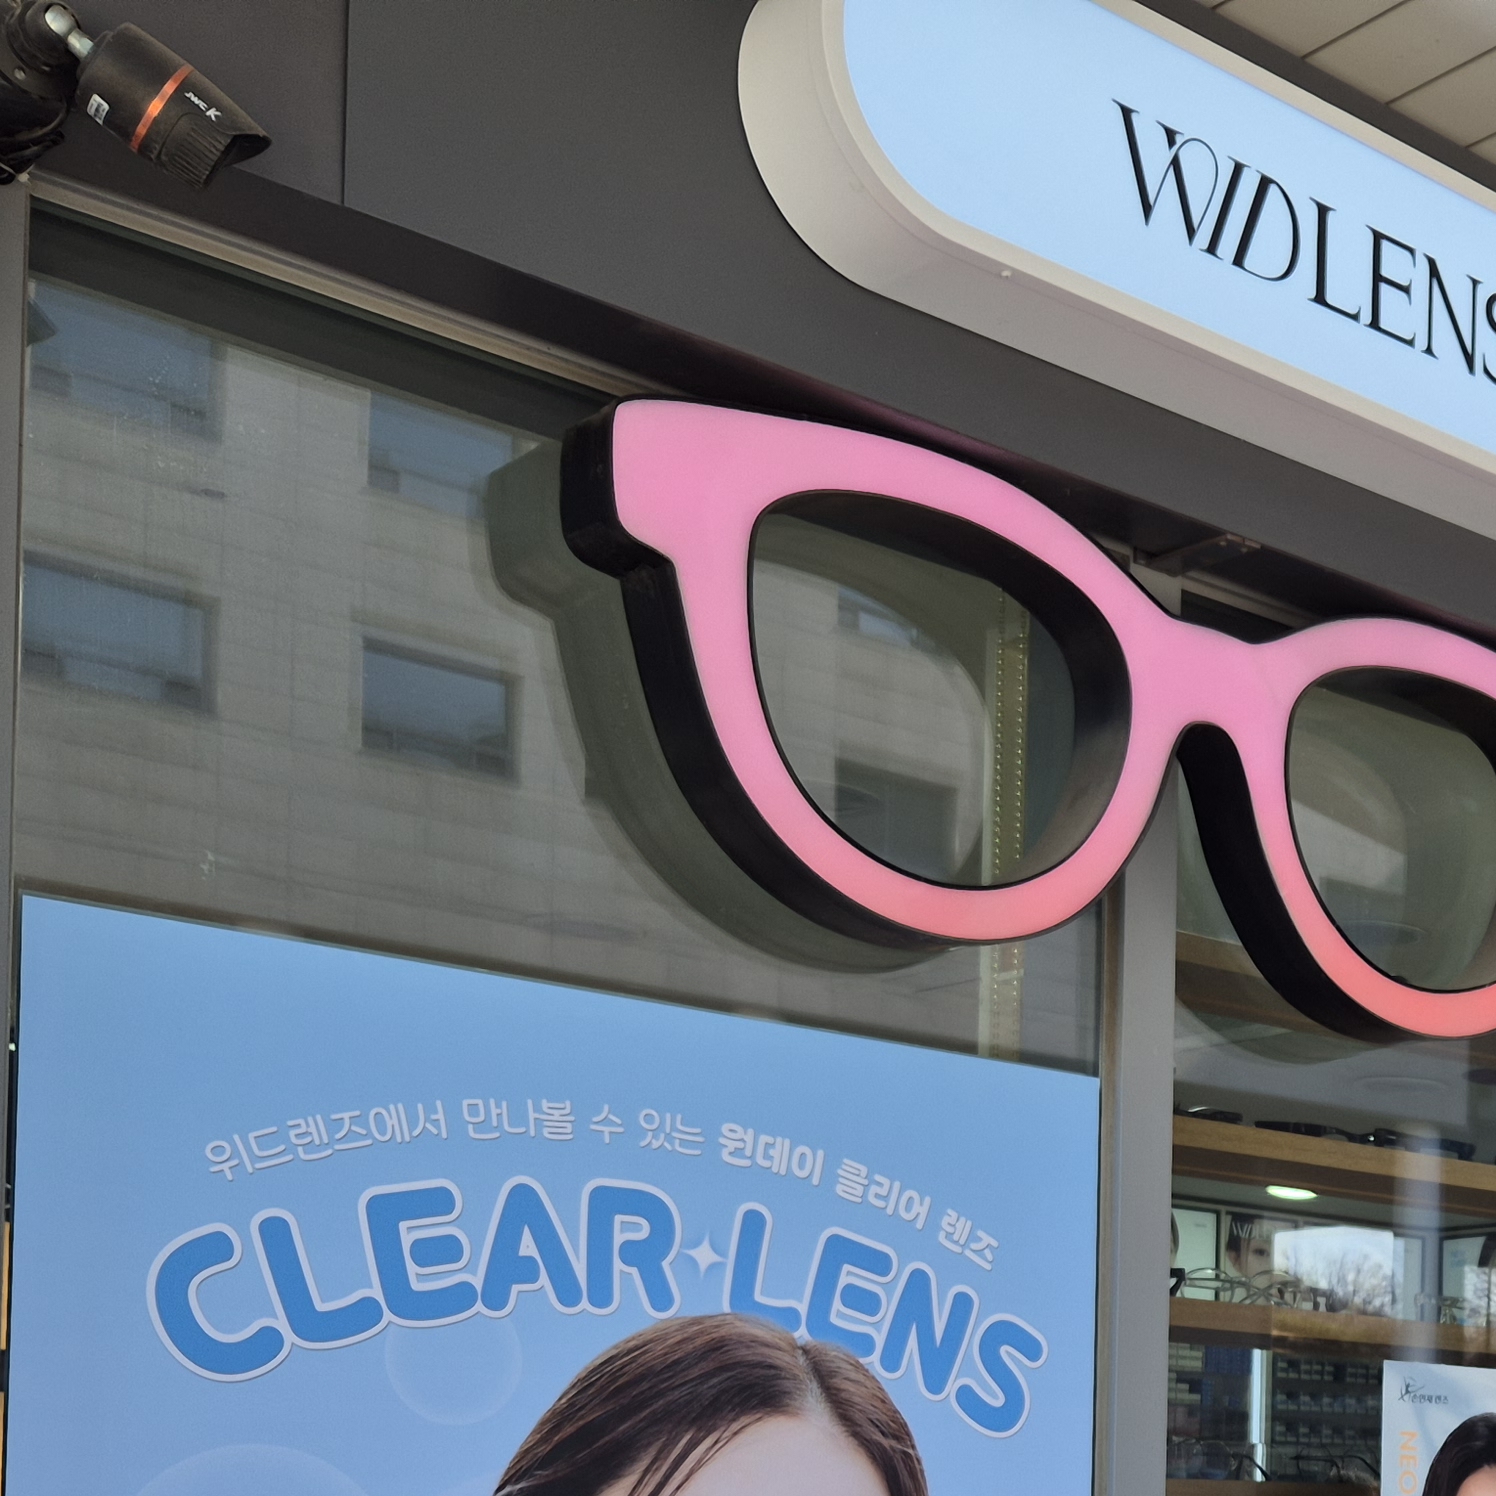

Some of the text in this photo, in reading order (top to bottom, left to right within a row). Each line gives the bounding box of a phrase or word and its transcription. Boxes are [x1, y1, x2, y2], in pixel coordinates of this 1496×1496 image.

[204, 1098, 1000, 1272] 위드렌즈에서 만나볼 수 있는 원데이 클리어 렌즈
[146, 1175, 1048, 1437] CLEAR LENS
